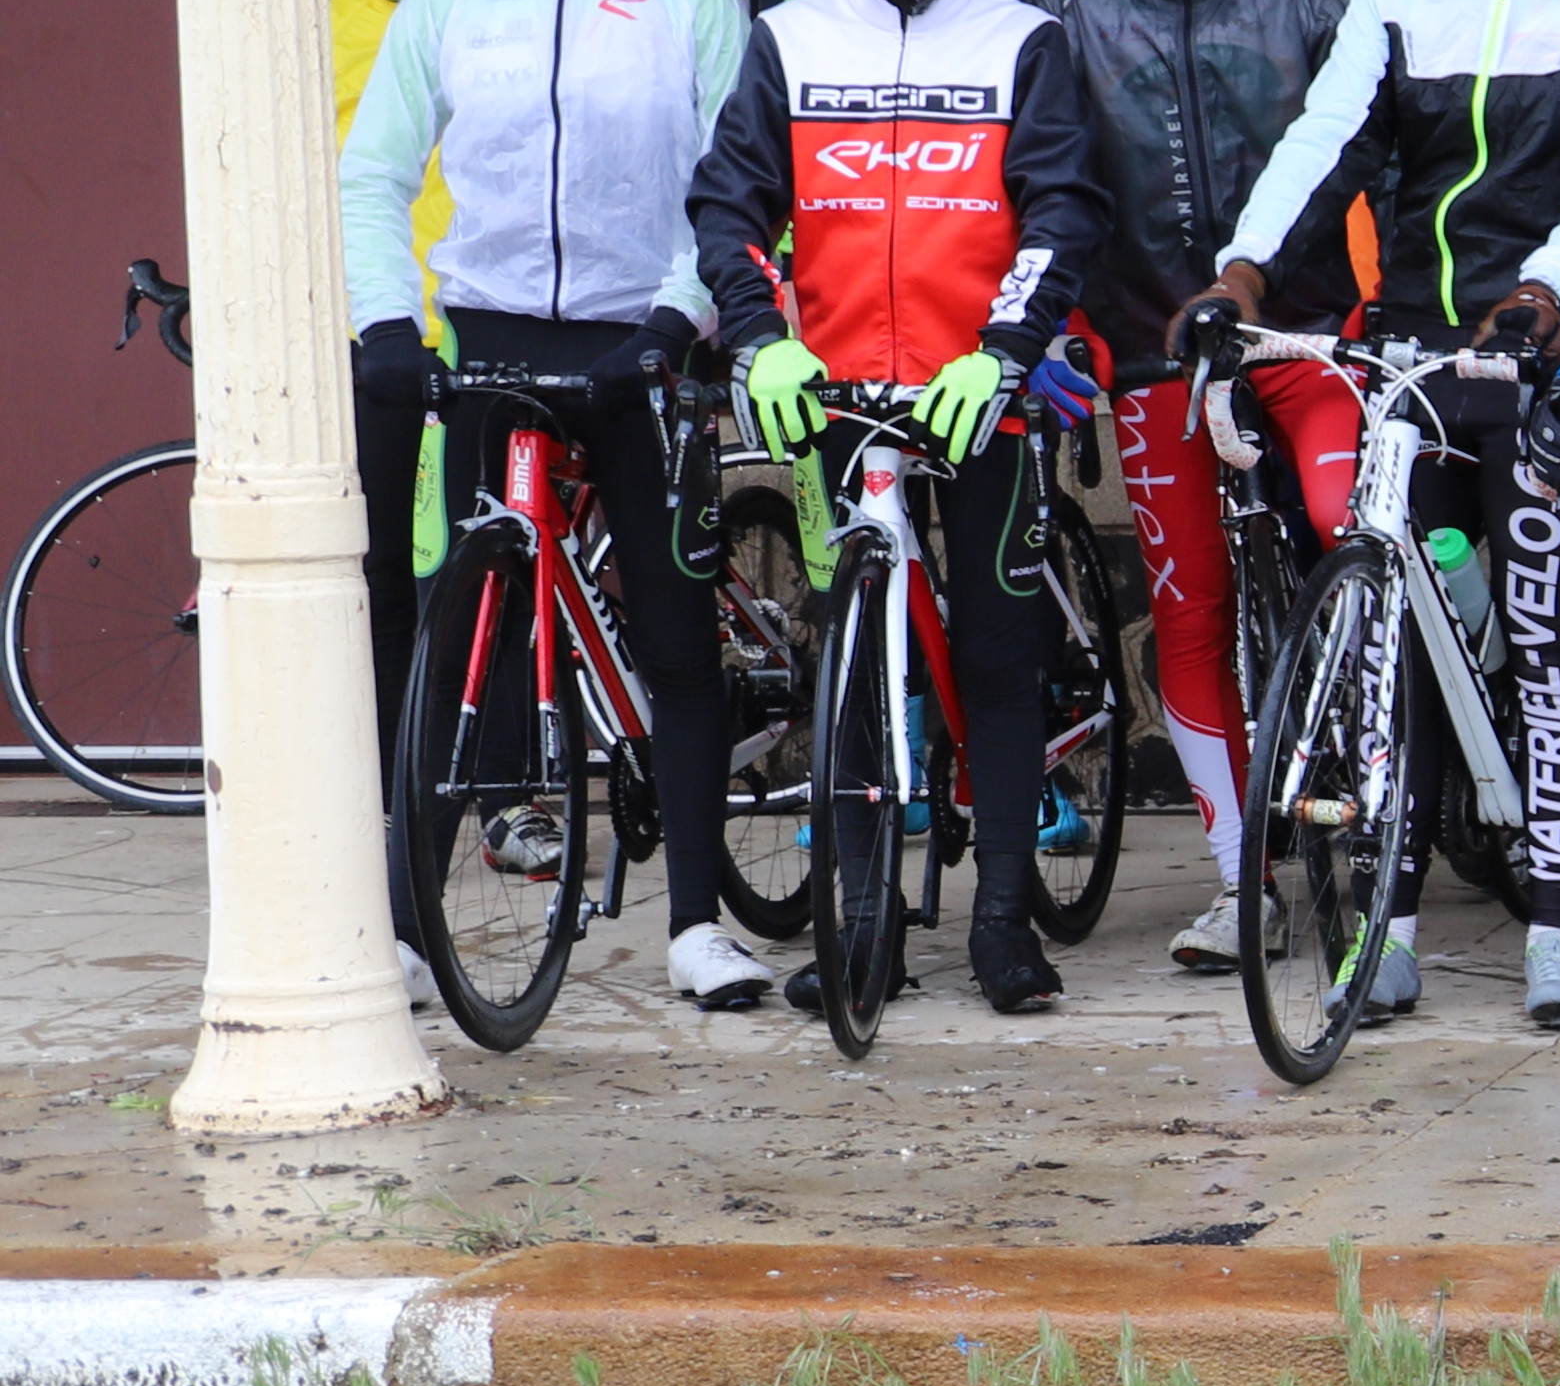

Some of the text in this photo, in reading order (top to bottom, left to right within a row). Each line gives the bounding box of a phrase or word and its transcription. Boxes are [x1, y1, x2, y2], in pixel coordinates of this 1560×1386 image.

[799, 197, 998, 213] LIMITED EDITION
[512, 444, 533, 502] BMC
